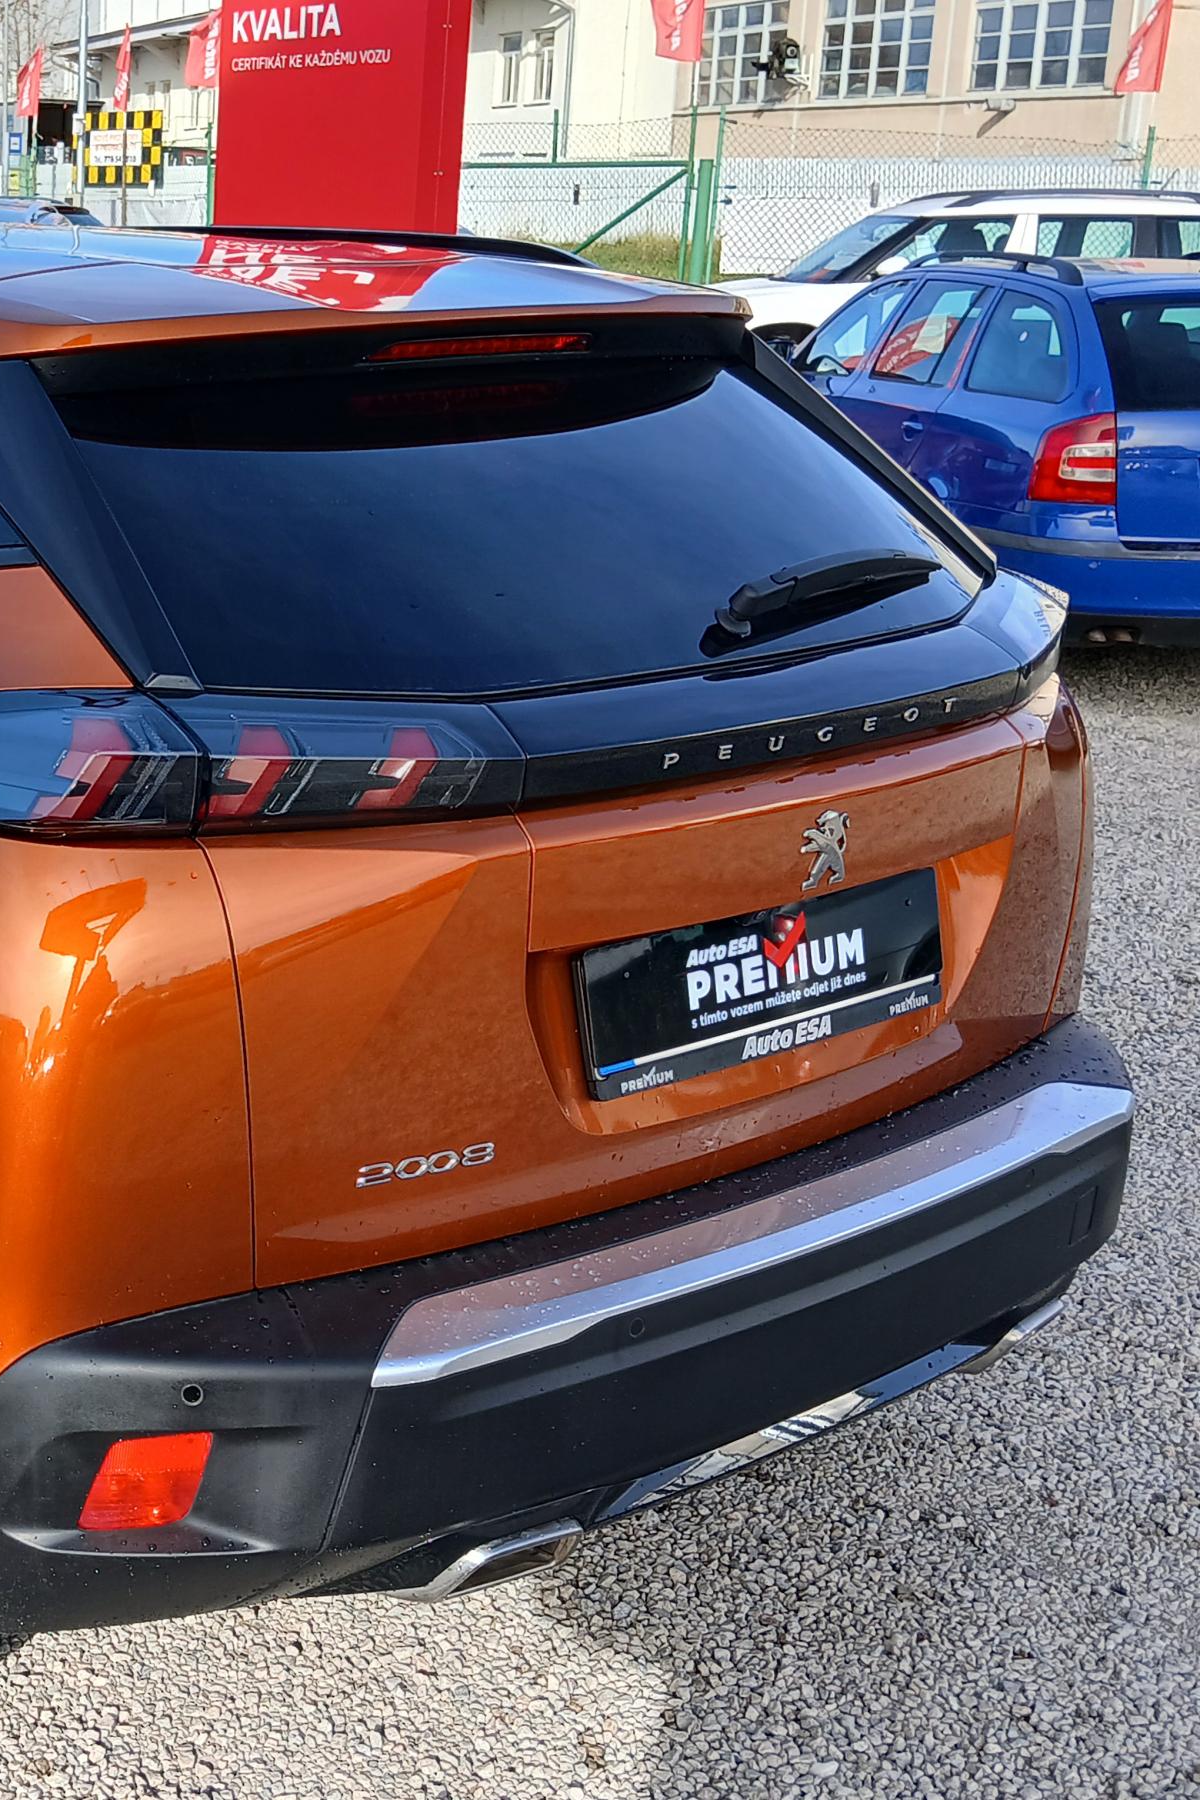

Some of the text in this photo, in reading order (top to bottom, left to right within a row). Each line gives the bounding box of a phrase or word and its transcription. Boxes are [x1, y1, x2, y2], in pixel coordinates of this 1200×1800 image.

[232, 3, 341, 43] KVALITA
[231, 49, 391, 72] CERTIFIKÁT KE KAŽDÉMU VOZU
[663, 697, 958, 769] PEUGEOT
[685, 934, 758, 968] Auto ESA
[691, 972, 866, 1029] s tímto vozem můžete odjet již dnes
[889, 990, 929, 1016] PREMIUM
[741, 1014, 832, 1060] Auto ESA
[620, 1066, 674, 1094] PREMIUM
[355, 1142, 495, 1188] 2008
